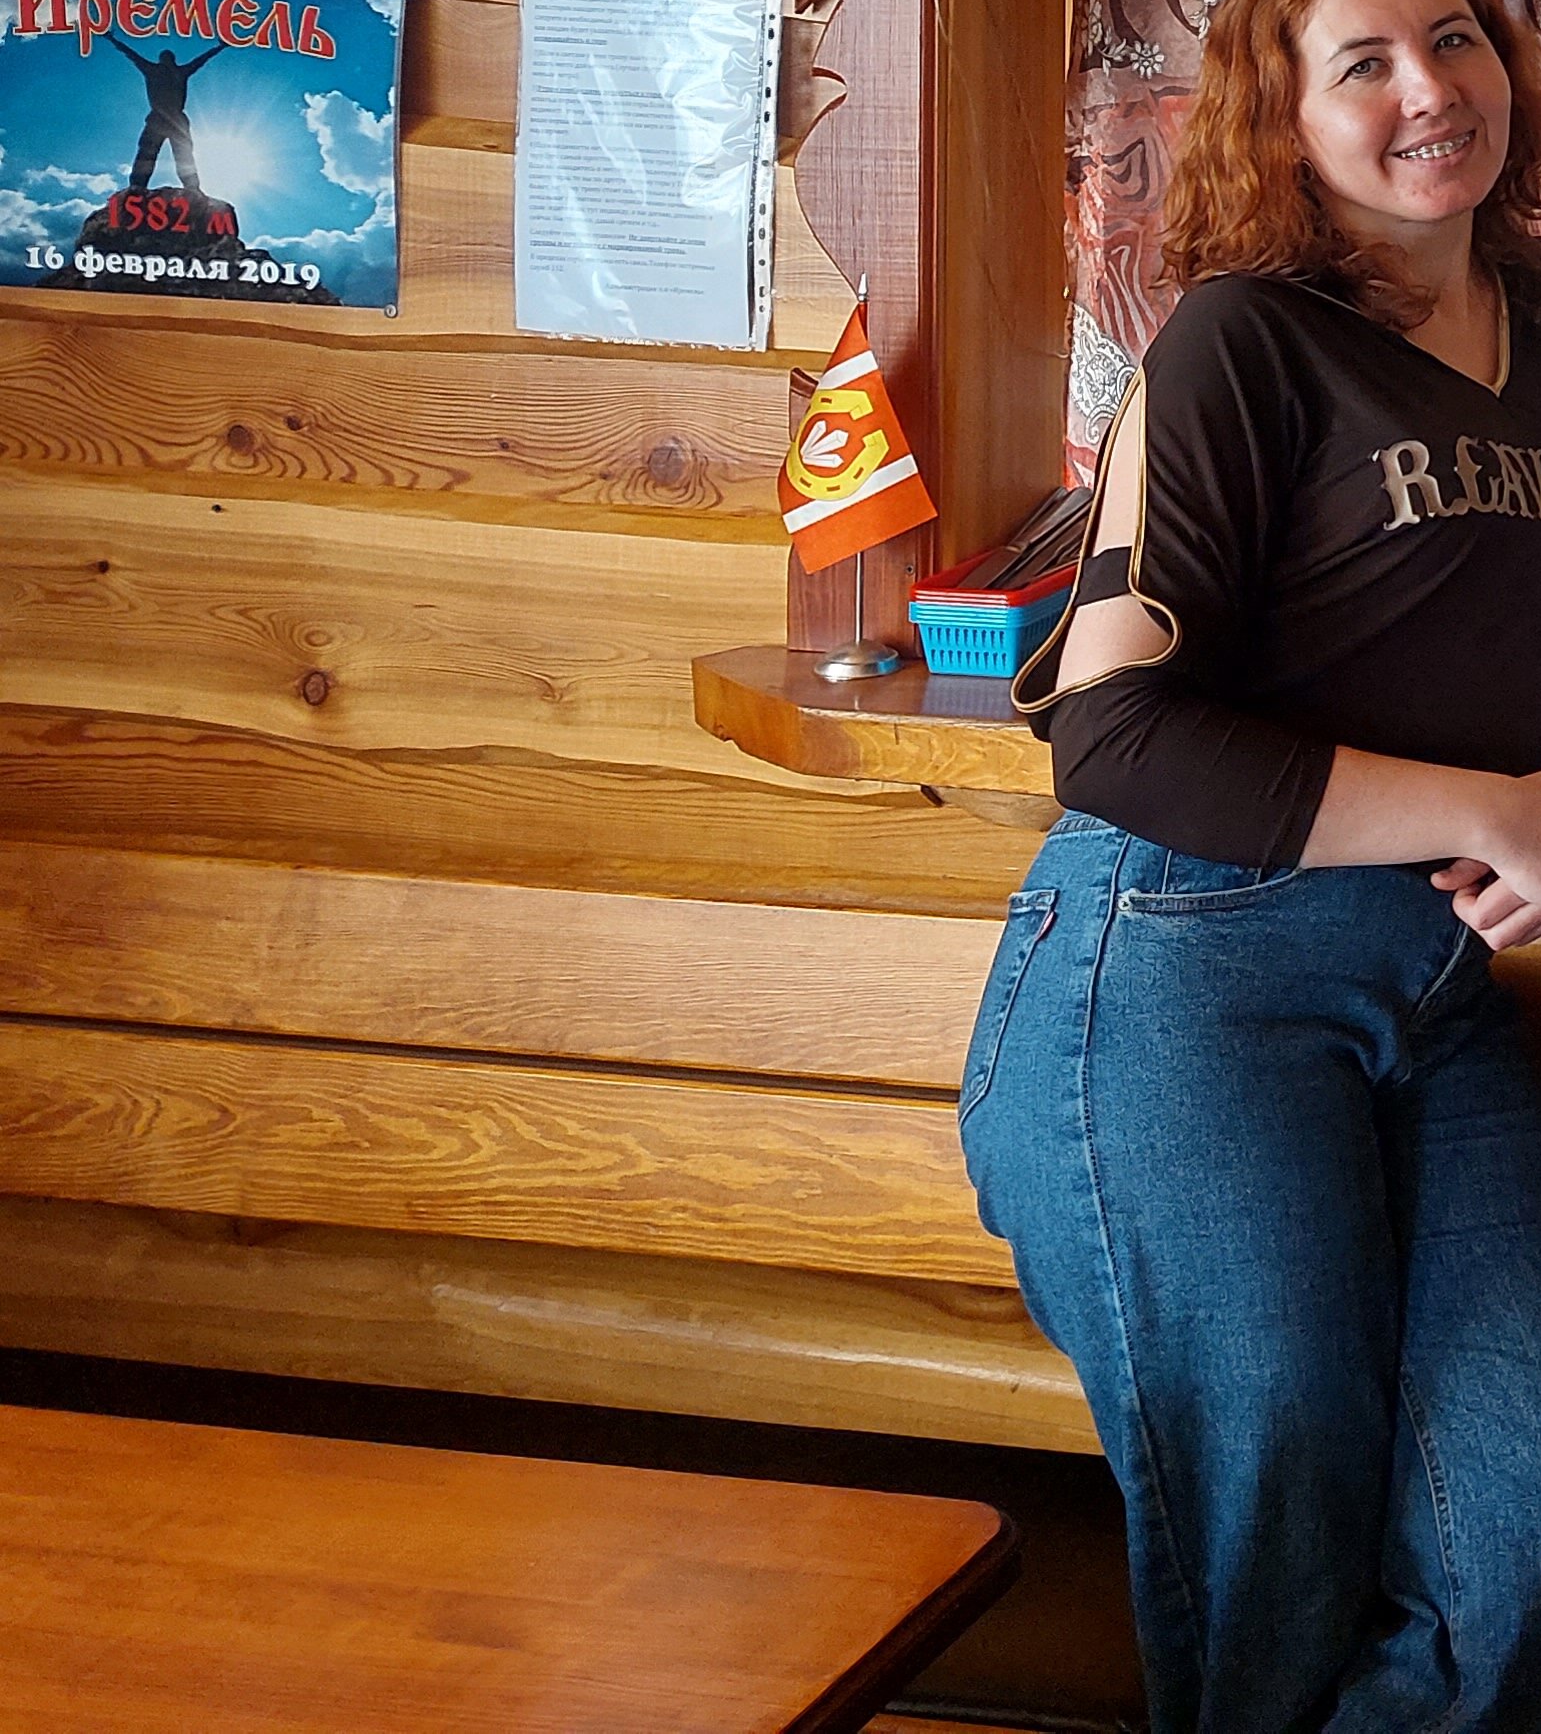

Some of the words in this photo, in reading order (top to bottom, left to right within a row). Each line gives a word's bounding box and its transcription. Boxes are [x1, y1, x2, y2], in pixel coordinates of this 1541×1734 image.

[106, 194, 192, 234] 1582
[24, 245, 64, 271] 16
[74, 243, 230, 283] февраля
[238, 259, 322, 291] 2019
